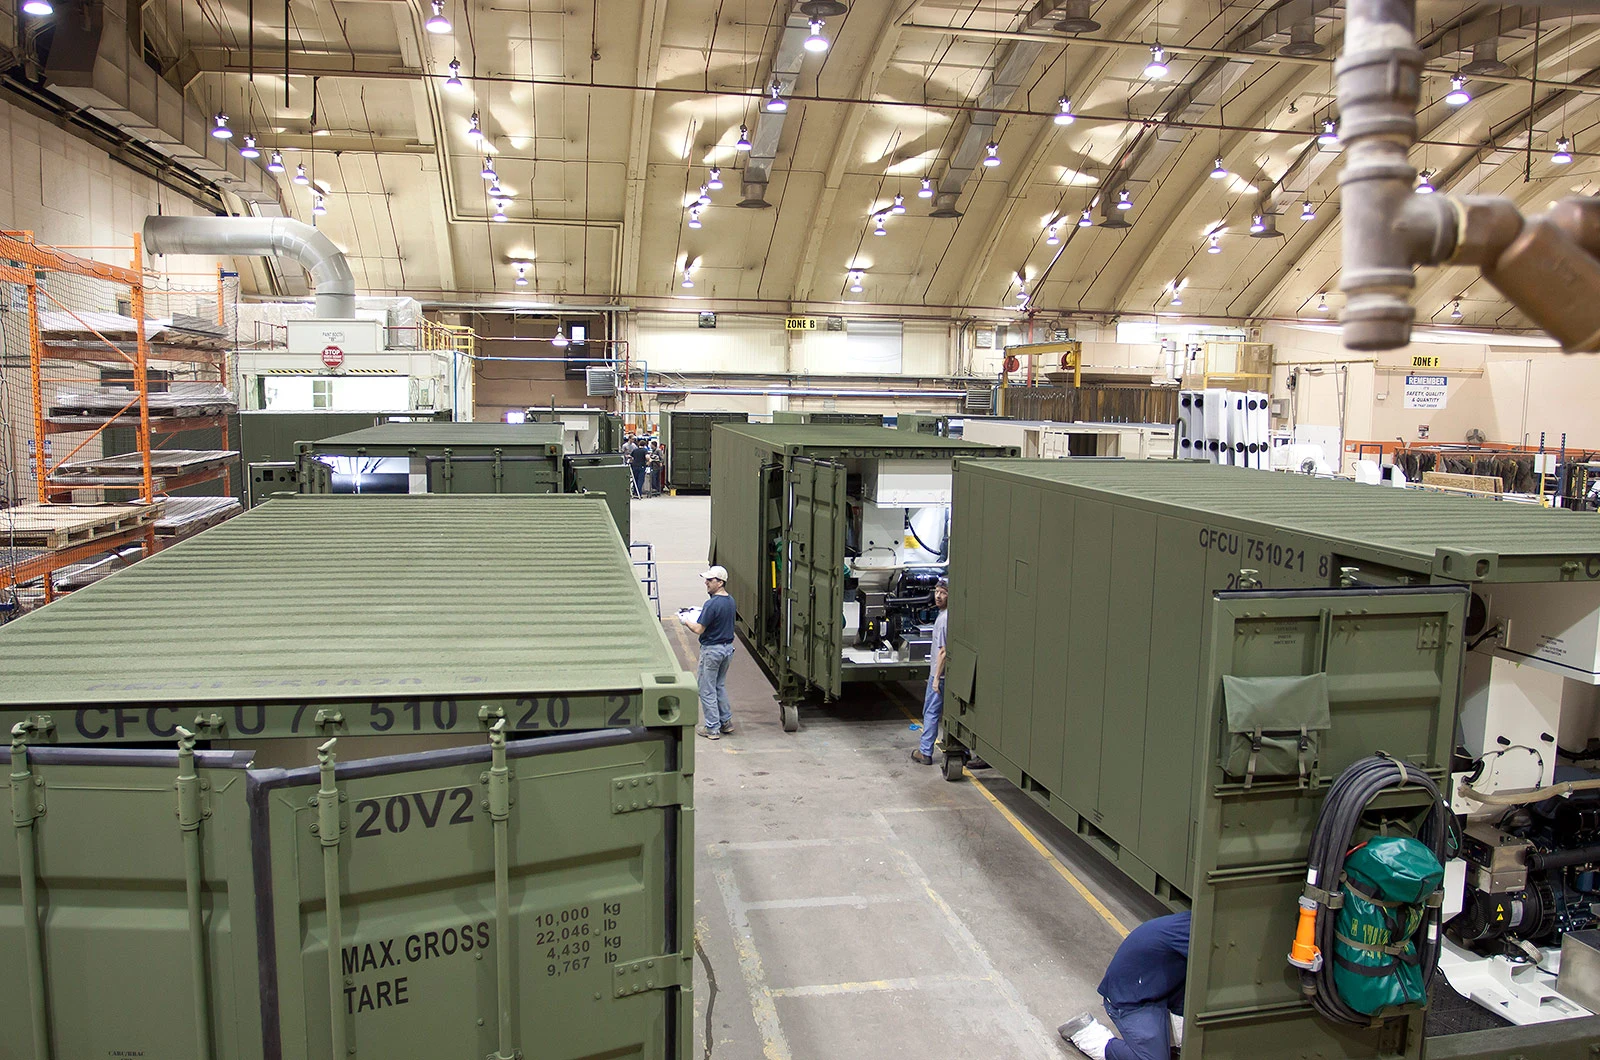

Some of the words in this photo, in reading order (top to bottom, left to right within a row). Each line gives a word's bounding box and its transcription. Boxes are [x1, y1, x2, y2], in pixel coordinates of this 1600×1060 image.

[787, 320, 806, 328] ZONE
[809, 320, 815, 328] B
[1413, 357, 1431, 366] ZONE
[1434, 358, 1439, 366] F
[1408, 377, 1445, 385] REMEMBER
[1199, 528, 1239, 555] CFCU
[1247, 538, 1305, 572] 751021
[1318, 555, 1328, 577] 8
[355, 787, 474, 838] 20V2
[535, 907, 589, 928] 10,000
[603, 903, 621, 916] kg
[536, 923, 590, 945] 22,046
[603, 919, 617, 931] lb
[546, 940, 590, 960] 4,430
[604, 936, 621, 949] kg
[547, 956, 590, 976] 9,767
[604, 952, 618, 964] lb
[343, 977, 409, 1015] TARE
